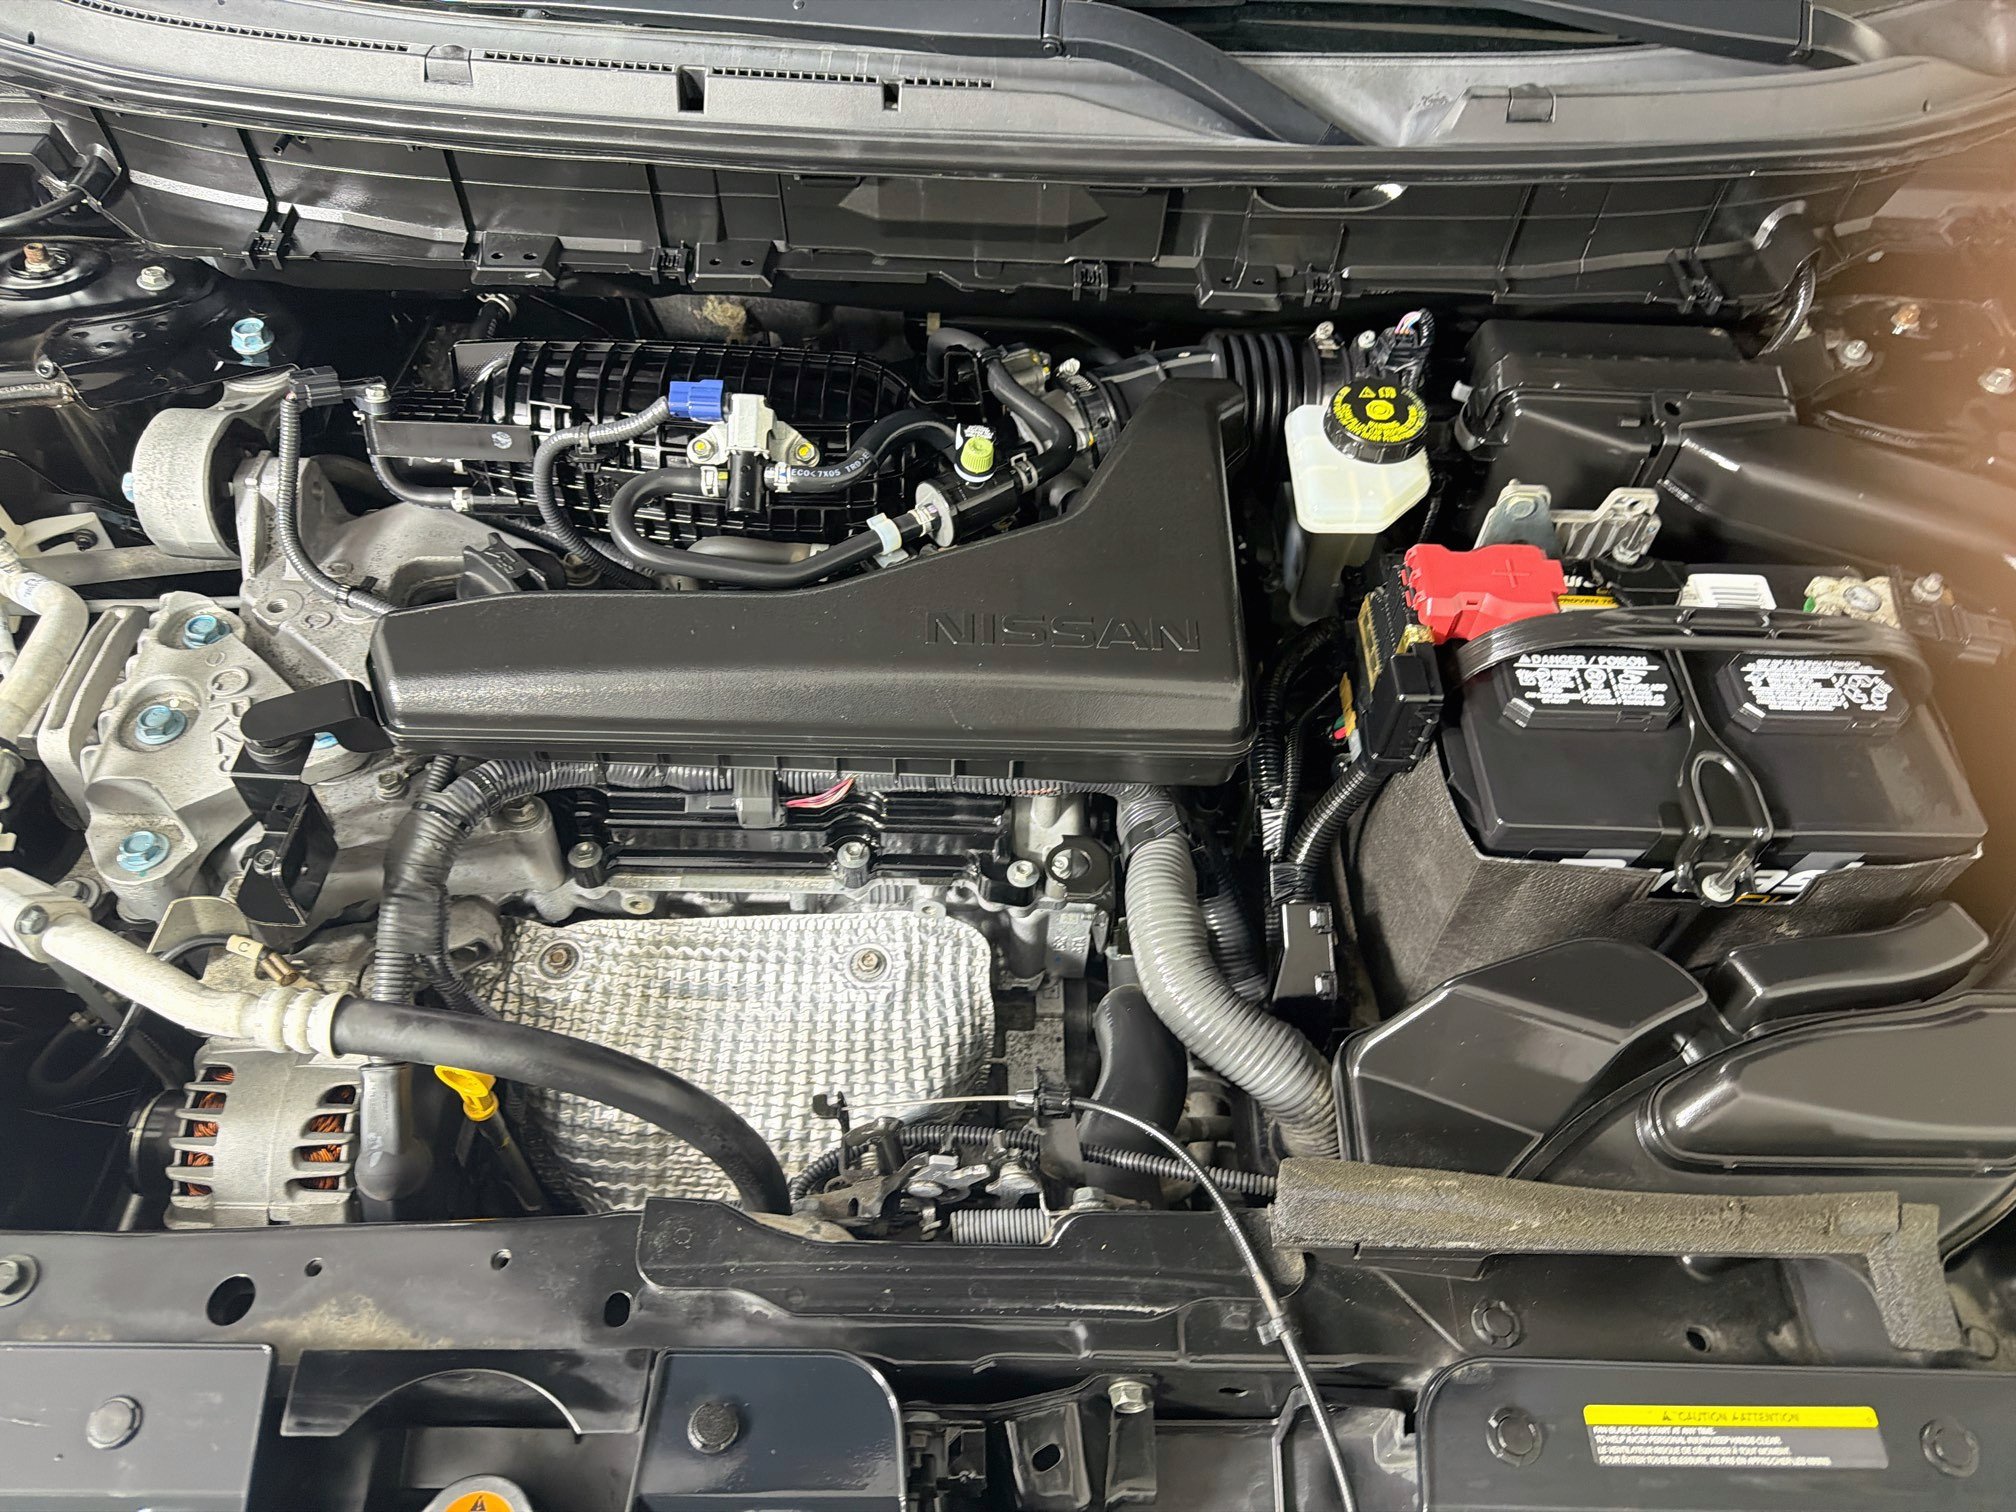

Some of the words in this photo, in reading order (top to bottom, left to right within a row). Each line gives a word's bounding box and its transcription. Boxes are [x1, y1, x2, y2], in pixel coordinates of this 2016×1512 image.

[924, 612, 1200, 652] NISSAN
[1531, 654, 1587, 666] DANGER
[1597, 655, 1649, 666] POISON
[1677, 1411, 1728, 1422] CAUTION
